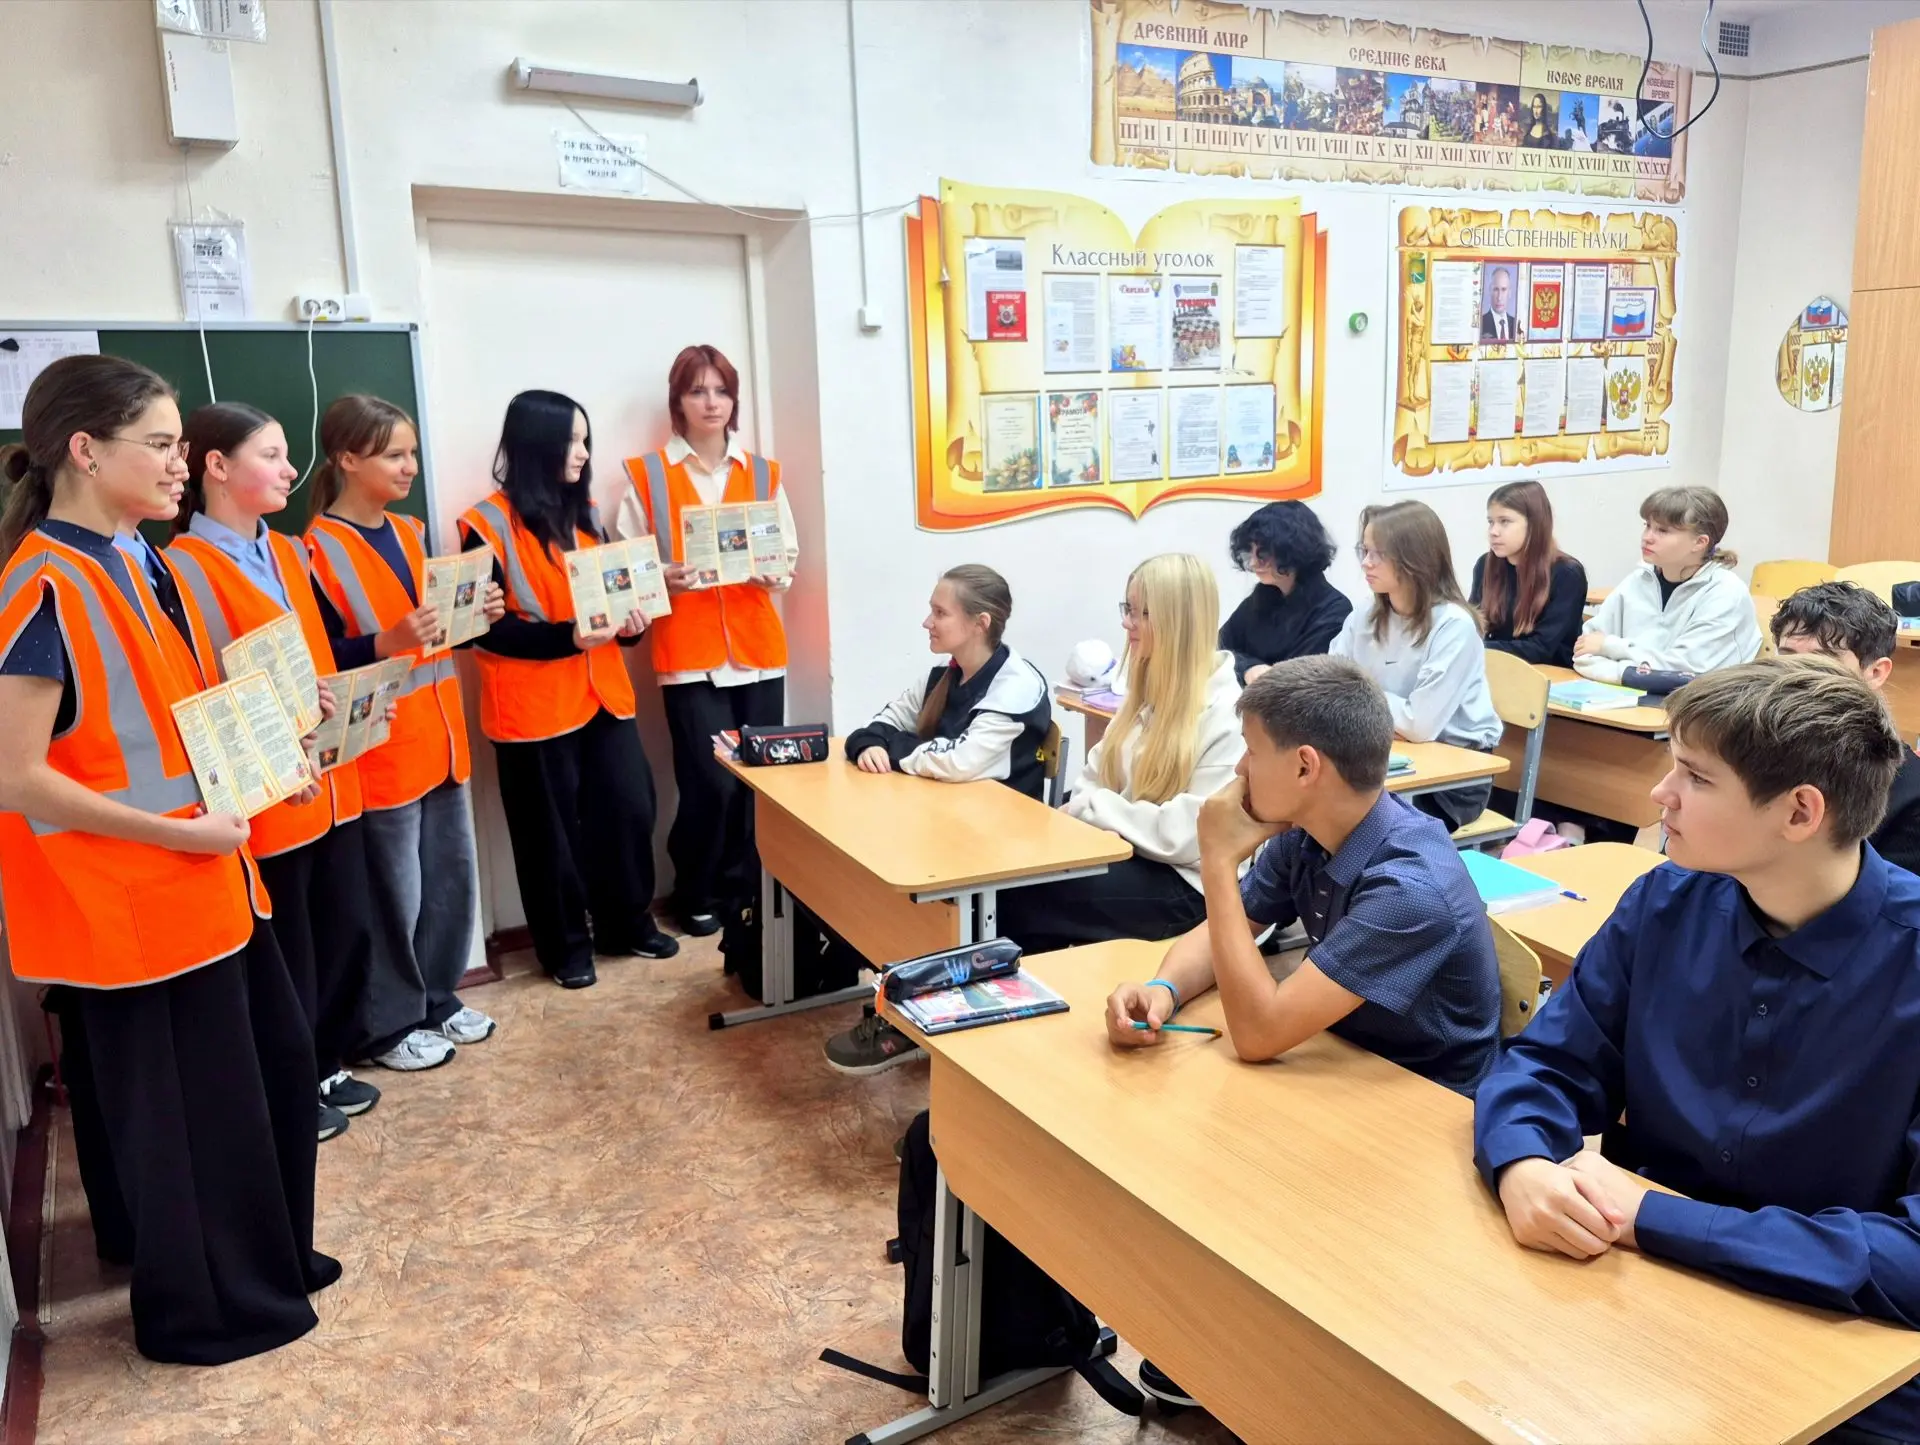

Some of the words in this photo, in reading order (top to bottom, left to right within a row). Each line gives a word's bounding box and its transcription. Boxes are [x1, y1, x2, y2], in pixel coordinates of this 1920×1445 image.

[1134, 22, 1209, 45] ДРЕВНИЙ
[1213, 30, 1249, 49] МИР
[1349, 47, 1410, 68] СРЕДНИЕ
[1414, 53, 1447, 72] ВЕКА
[1546, 69, 1582, 87] НОВОЕ
[1585, 74, 1624, 91] ВРЕМЯ
[1120, 122, 1138, 139] III
[1144, 124, 1156, 140] II
[1196, 128, 1207, 145] II
[1212, 130, 1228, 146] III
[1233, 131, 1249, 148] IV
[1274, 134, 1288, 151] VI
[1296, 136, 1316, 152] VII
[1324, 138, 1349, 155] VIII
[1355, 140, 1369, 156] IX
[1393, 143, 1407, 158] XI
[1415, 145, 1433, 160] XII
[1440, 146, 1463, 162] XIII
[1468, 148, 1491, 164] XIV
[1496, 150, 1513, 165] XV
[1521, 152, 1542, 167] XVI
[1548, 154, 1573, 169] XVII
[1577, 155, 1606, 172] XVIII
[1612, 157, 1630, 173] XIX
[1636, 160, 1650, 174] XX
[1460, 227, 1578, 249] ОБЩЕСТВЕННЫЕ
[1583, 231, 1628, 249] НАУКИ
[1052, 244, 1147, 268] Классный
[1153, 250, 1215, 272] уголок
